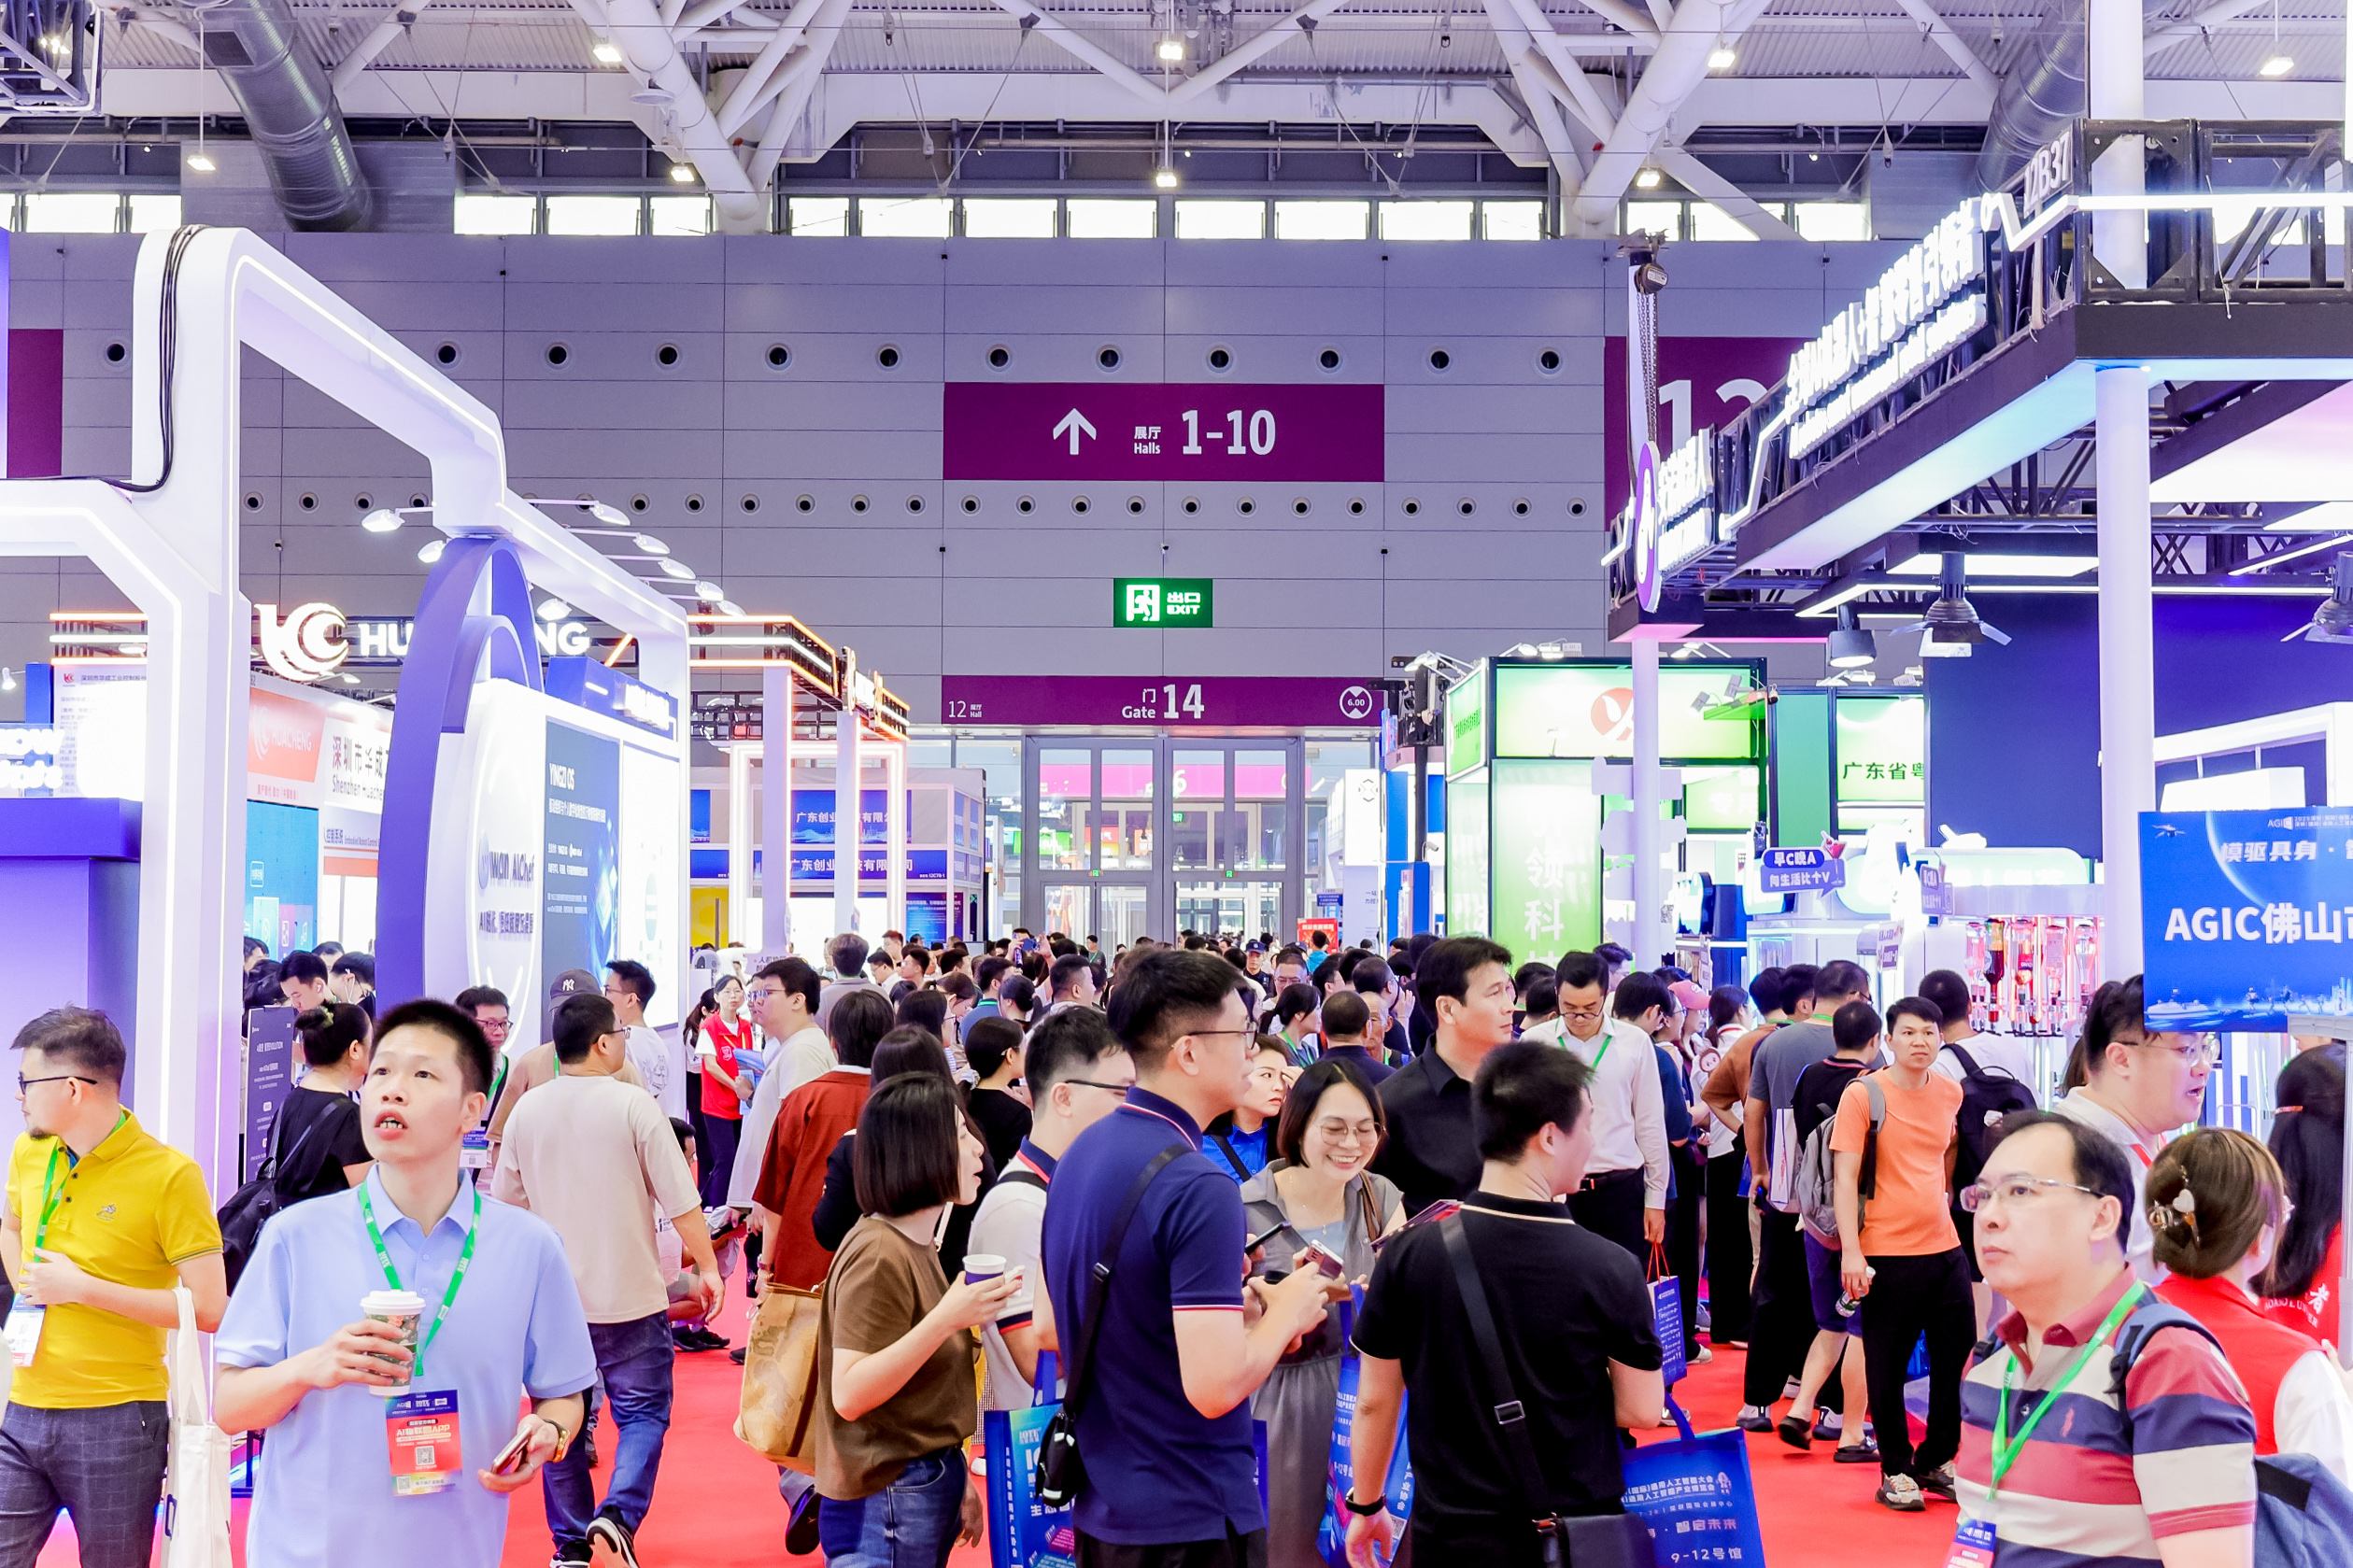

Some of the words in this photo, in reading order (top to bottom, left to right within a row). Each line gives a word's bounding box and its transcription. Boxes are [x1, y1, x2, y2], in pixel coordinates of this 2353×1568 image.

[2023, 131, 2070, 219] 12B37
[1134, 426, 1161, 440] 展厅
[1182, 409, 1276, 456] 1-10
[1134, 442, 1161, 455] Halls
[1167, 591, 1201, 604] 出口
[1167, 604, 1201, 614] EXIT
[948, 700, 966, 718] 12
[1142, 688, 1156, 703] 门
[1163, 684, 1205, 719] 14
[1347, 698, 1366, 707] 6.00
[1122, 705, 1156, 718] Gate
[333, 734, 389, 778] 深圳市华成
[1774, 851, 1816, 867] 早C晚A
[563, 979, 574, 991] NY
[1671, 1547, 1743, 1563] 9-12号馆
